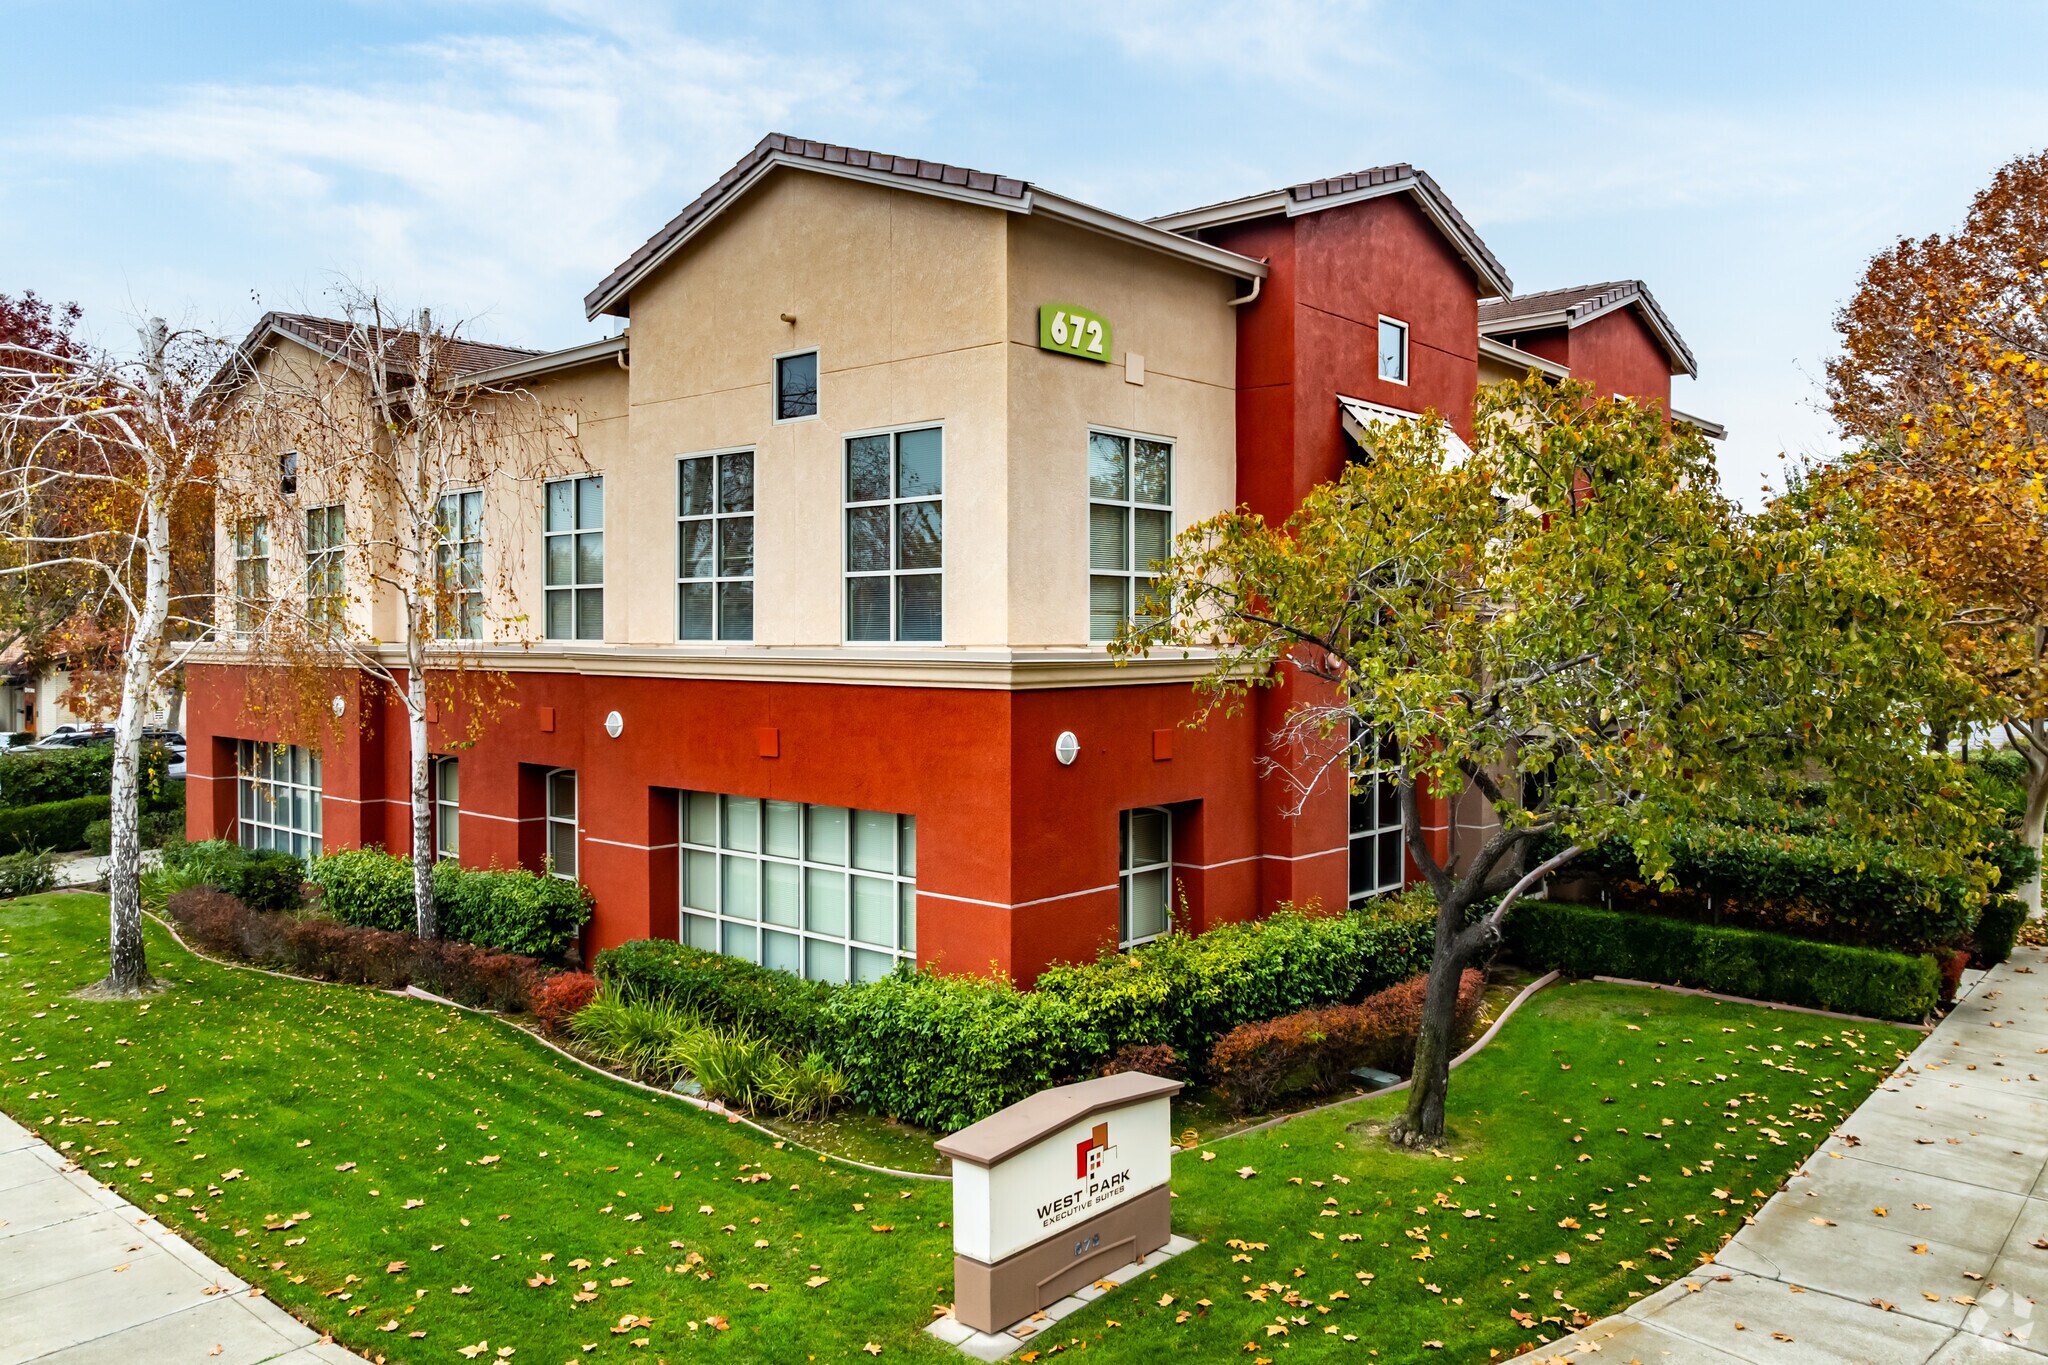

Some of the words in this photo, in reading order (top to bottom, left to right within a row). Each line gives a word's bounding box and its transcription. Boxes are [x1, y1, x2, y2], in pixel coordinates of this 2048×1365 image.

[1051, 311, 1103, 354] 672
[1037, 1190, 1083, 1219] WEST
[1090, 1169, 1130, 1196] PARK
[1043, 1200, 1093, 1227] EXECUTIVE
[1096, 1185, 1125, 1204] SUITES
